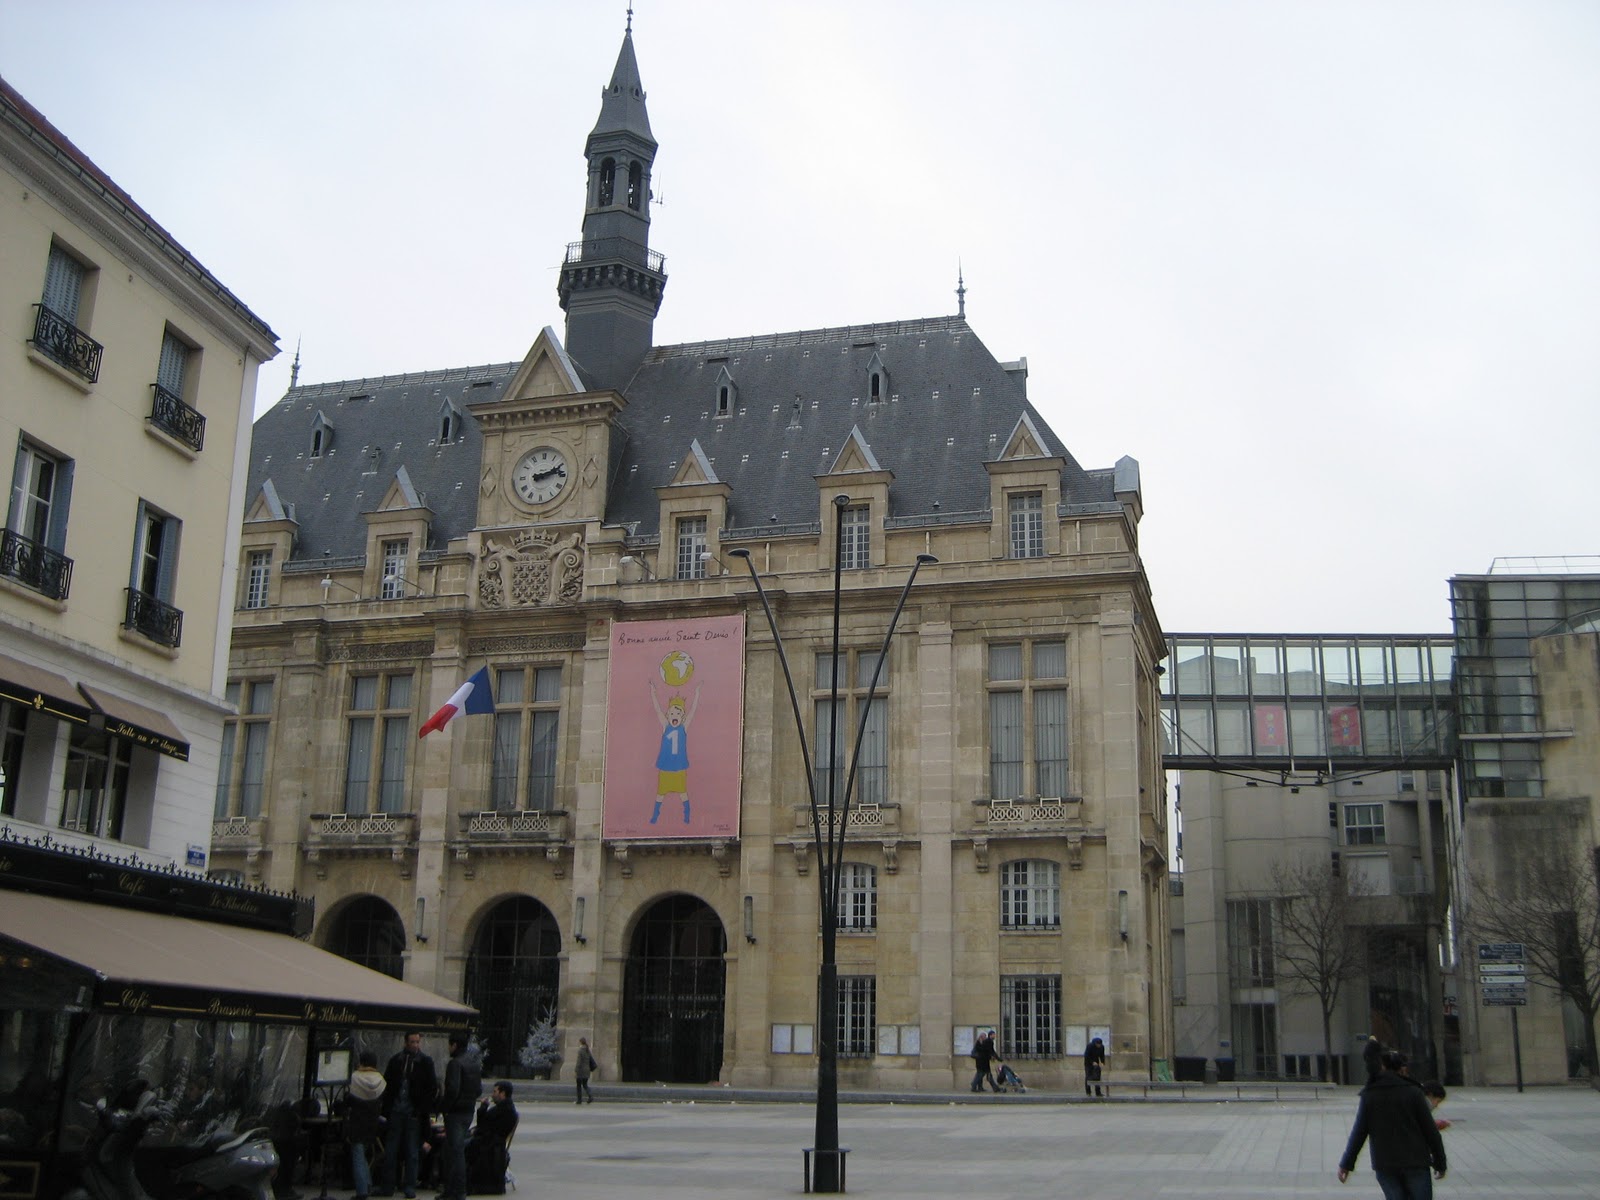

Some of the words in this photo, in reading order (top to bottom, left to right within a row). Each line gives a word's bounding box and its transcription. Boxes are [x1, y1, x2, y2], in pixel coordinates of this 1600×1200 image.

[676, 630, 701, 642] Saint
[666, 730, 679, 755] 1
[118, 872, 145, 896] Café
[121, 988, 150, 1015] Café
[208, 998, 254, 1017] Brasserie
[303, 1002, 318, 1021] Le
